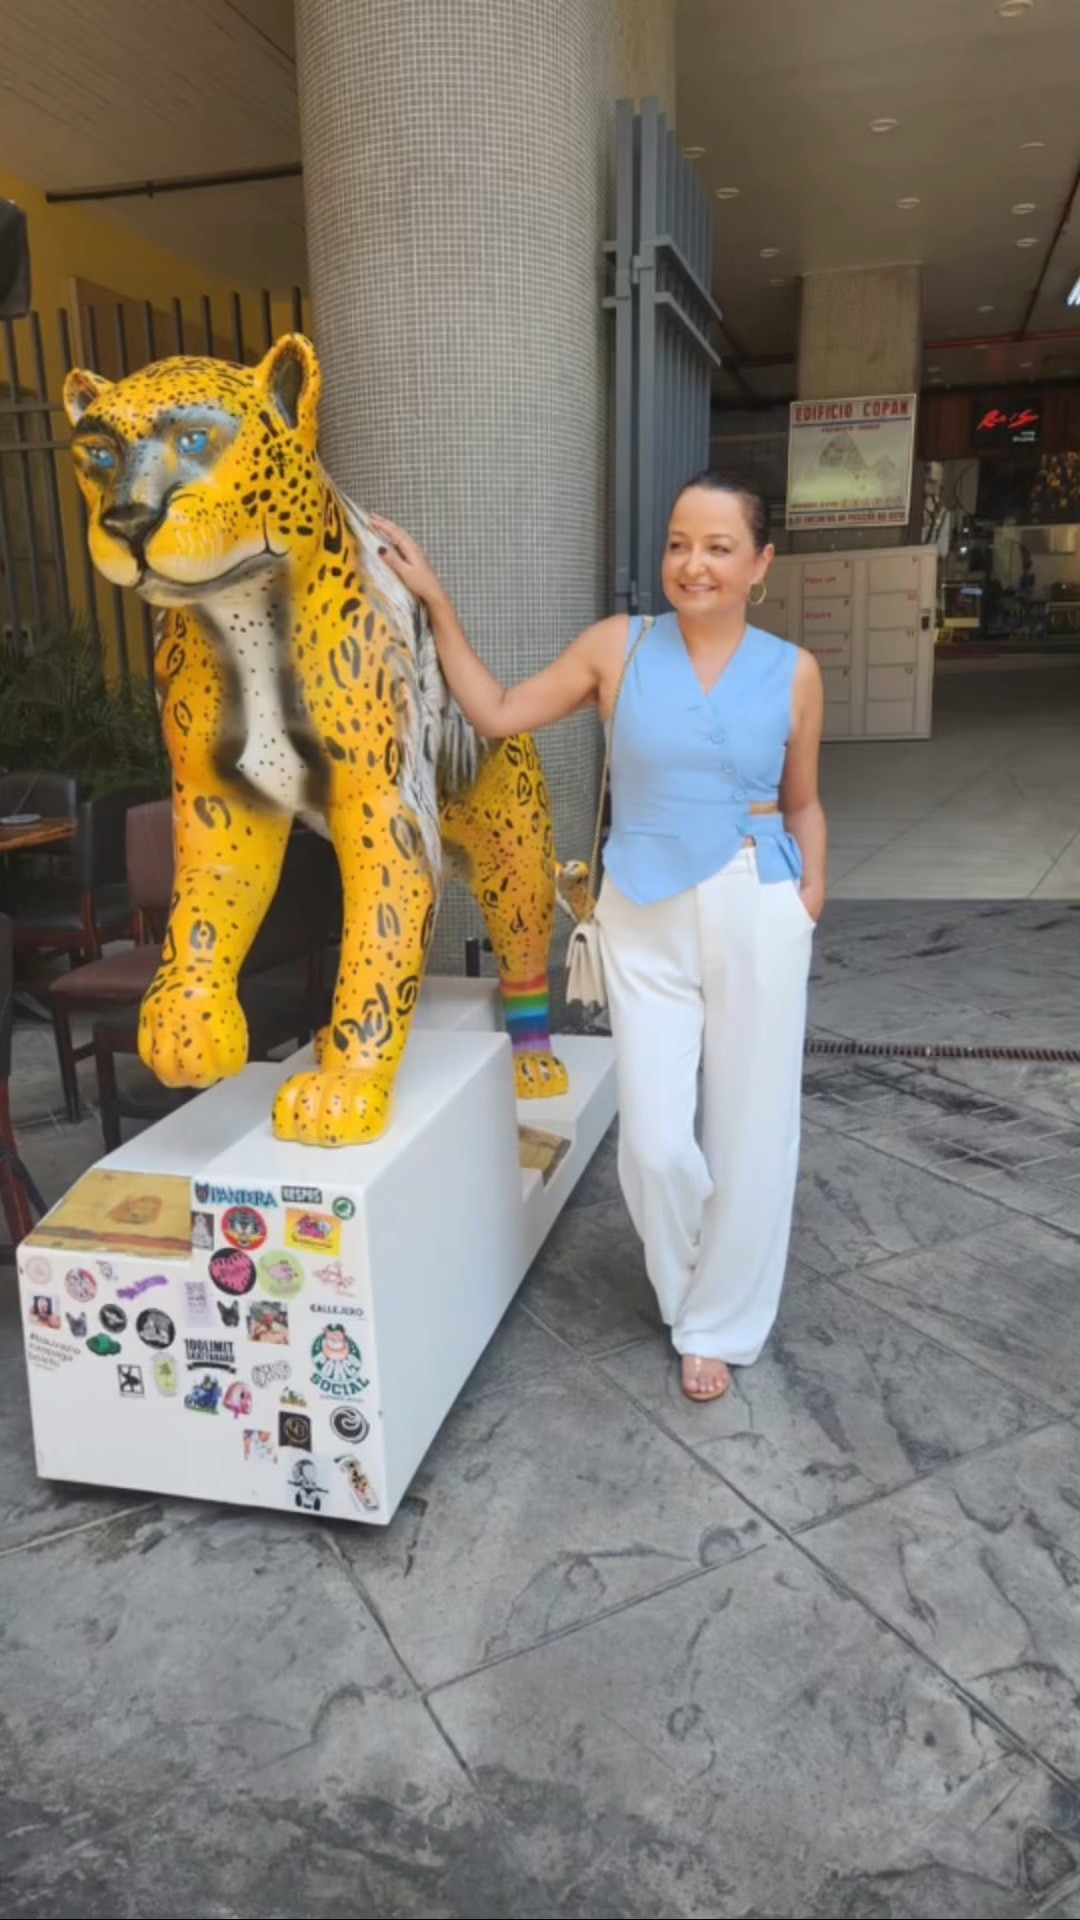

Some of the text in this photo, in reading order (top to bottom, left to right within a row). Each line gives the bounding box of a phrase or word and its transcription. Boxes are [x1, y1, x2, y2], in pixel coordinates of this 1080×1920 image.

[863, 400, 909, 417] COPAN
[211, 1187, 278, 1208] PANTERA
[310, 1372, 371, 1396] SOCIAL
